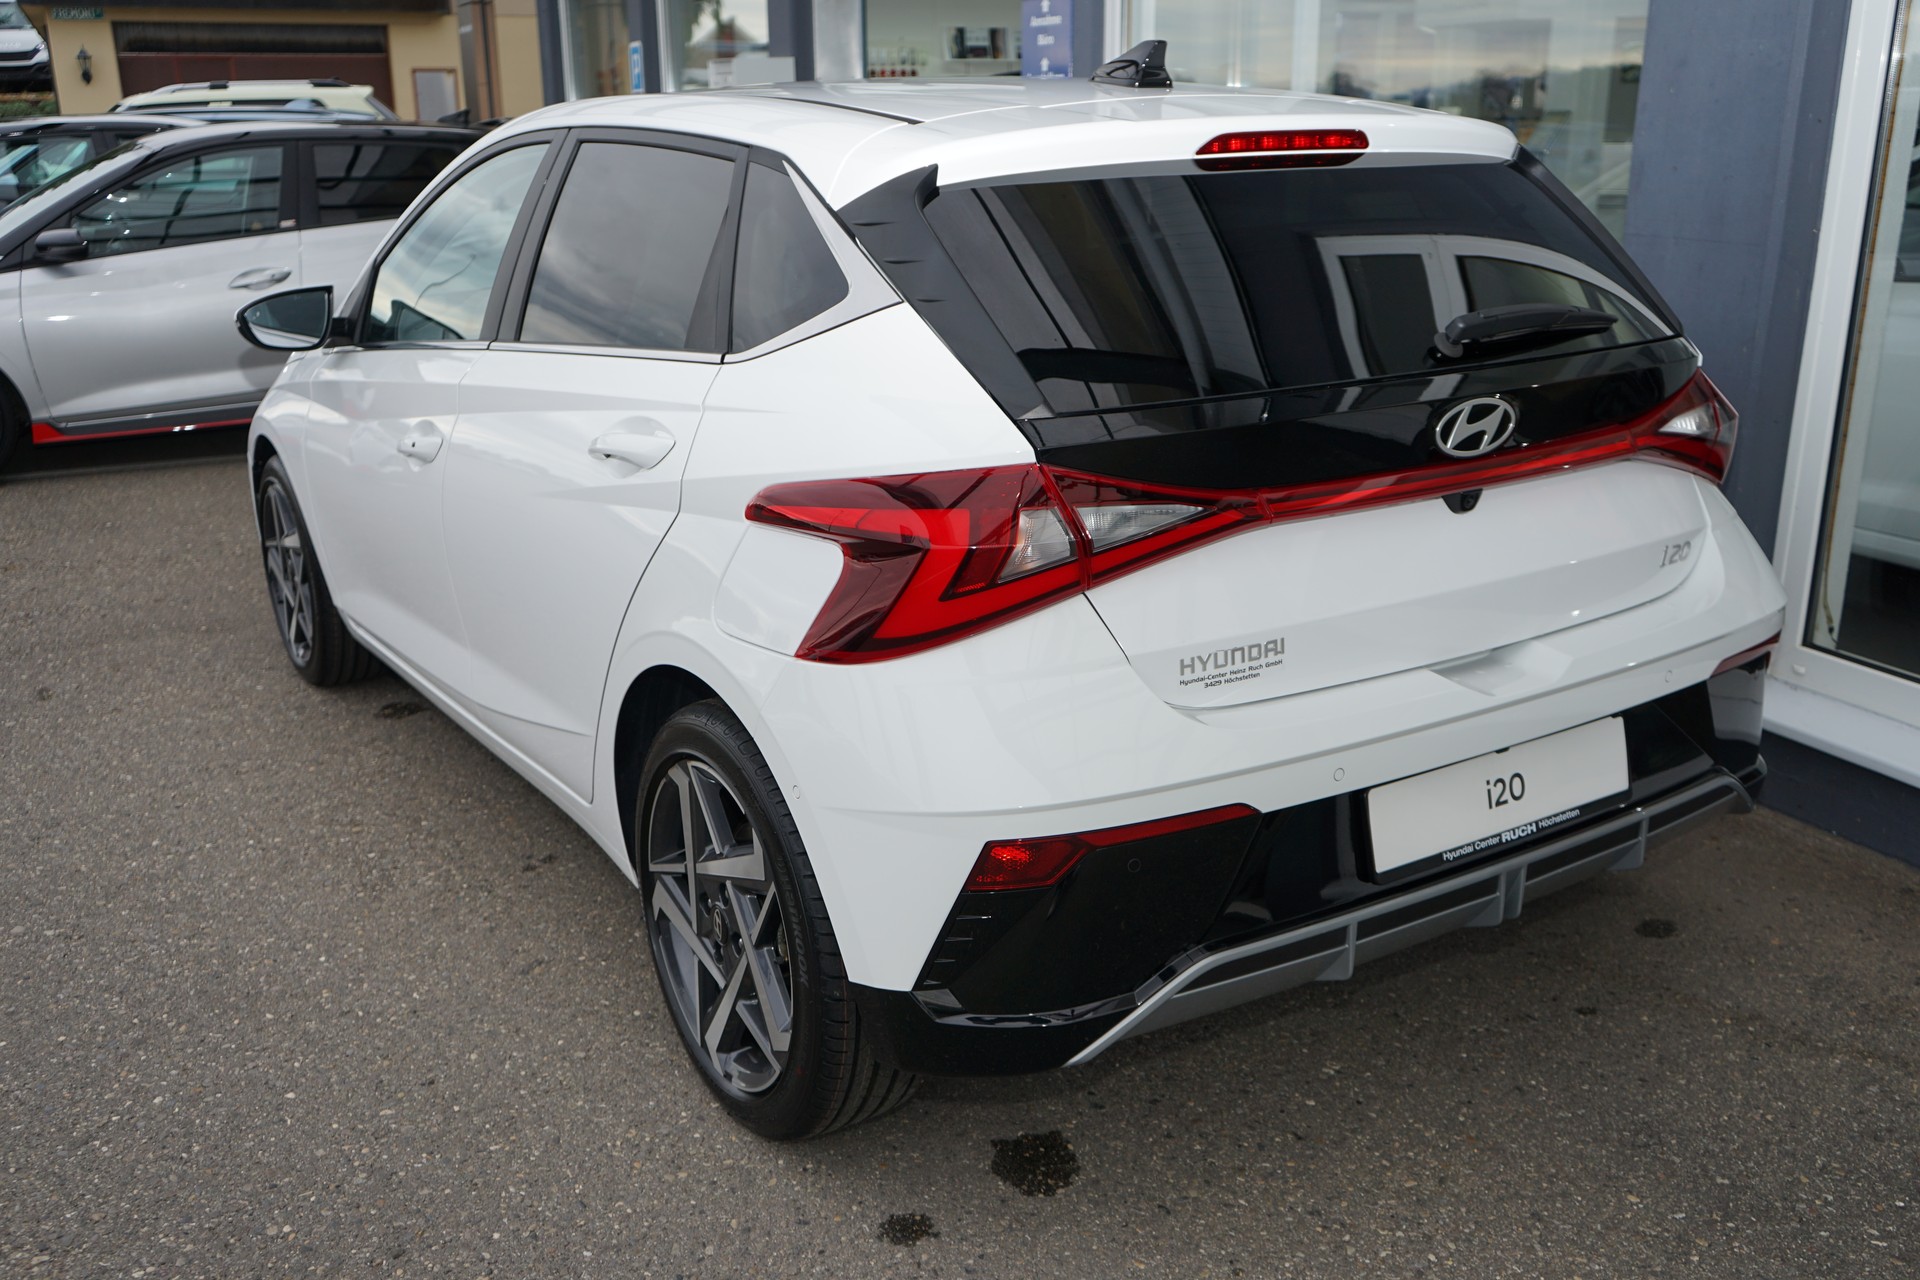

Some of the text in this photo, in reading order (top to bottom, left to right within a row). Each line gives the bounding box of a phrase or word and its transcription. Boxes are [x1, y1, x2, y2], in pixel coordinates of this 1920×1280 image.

[1179, 637, 1285, 676] HYUNDAI
[1179, 659, 1283, 686] Hyundai-Center Heinz Ruch GmbH
[1204, 672, 1260, 688] 3429 Höchstetten
[1485, 772, 1526, 810] i20
[1442, 809, 1581, 861] Hyundai Center RUCH Höchstetten
